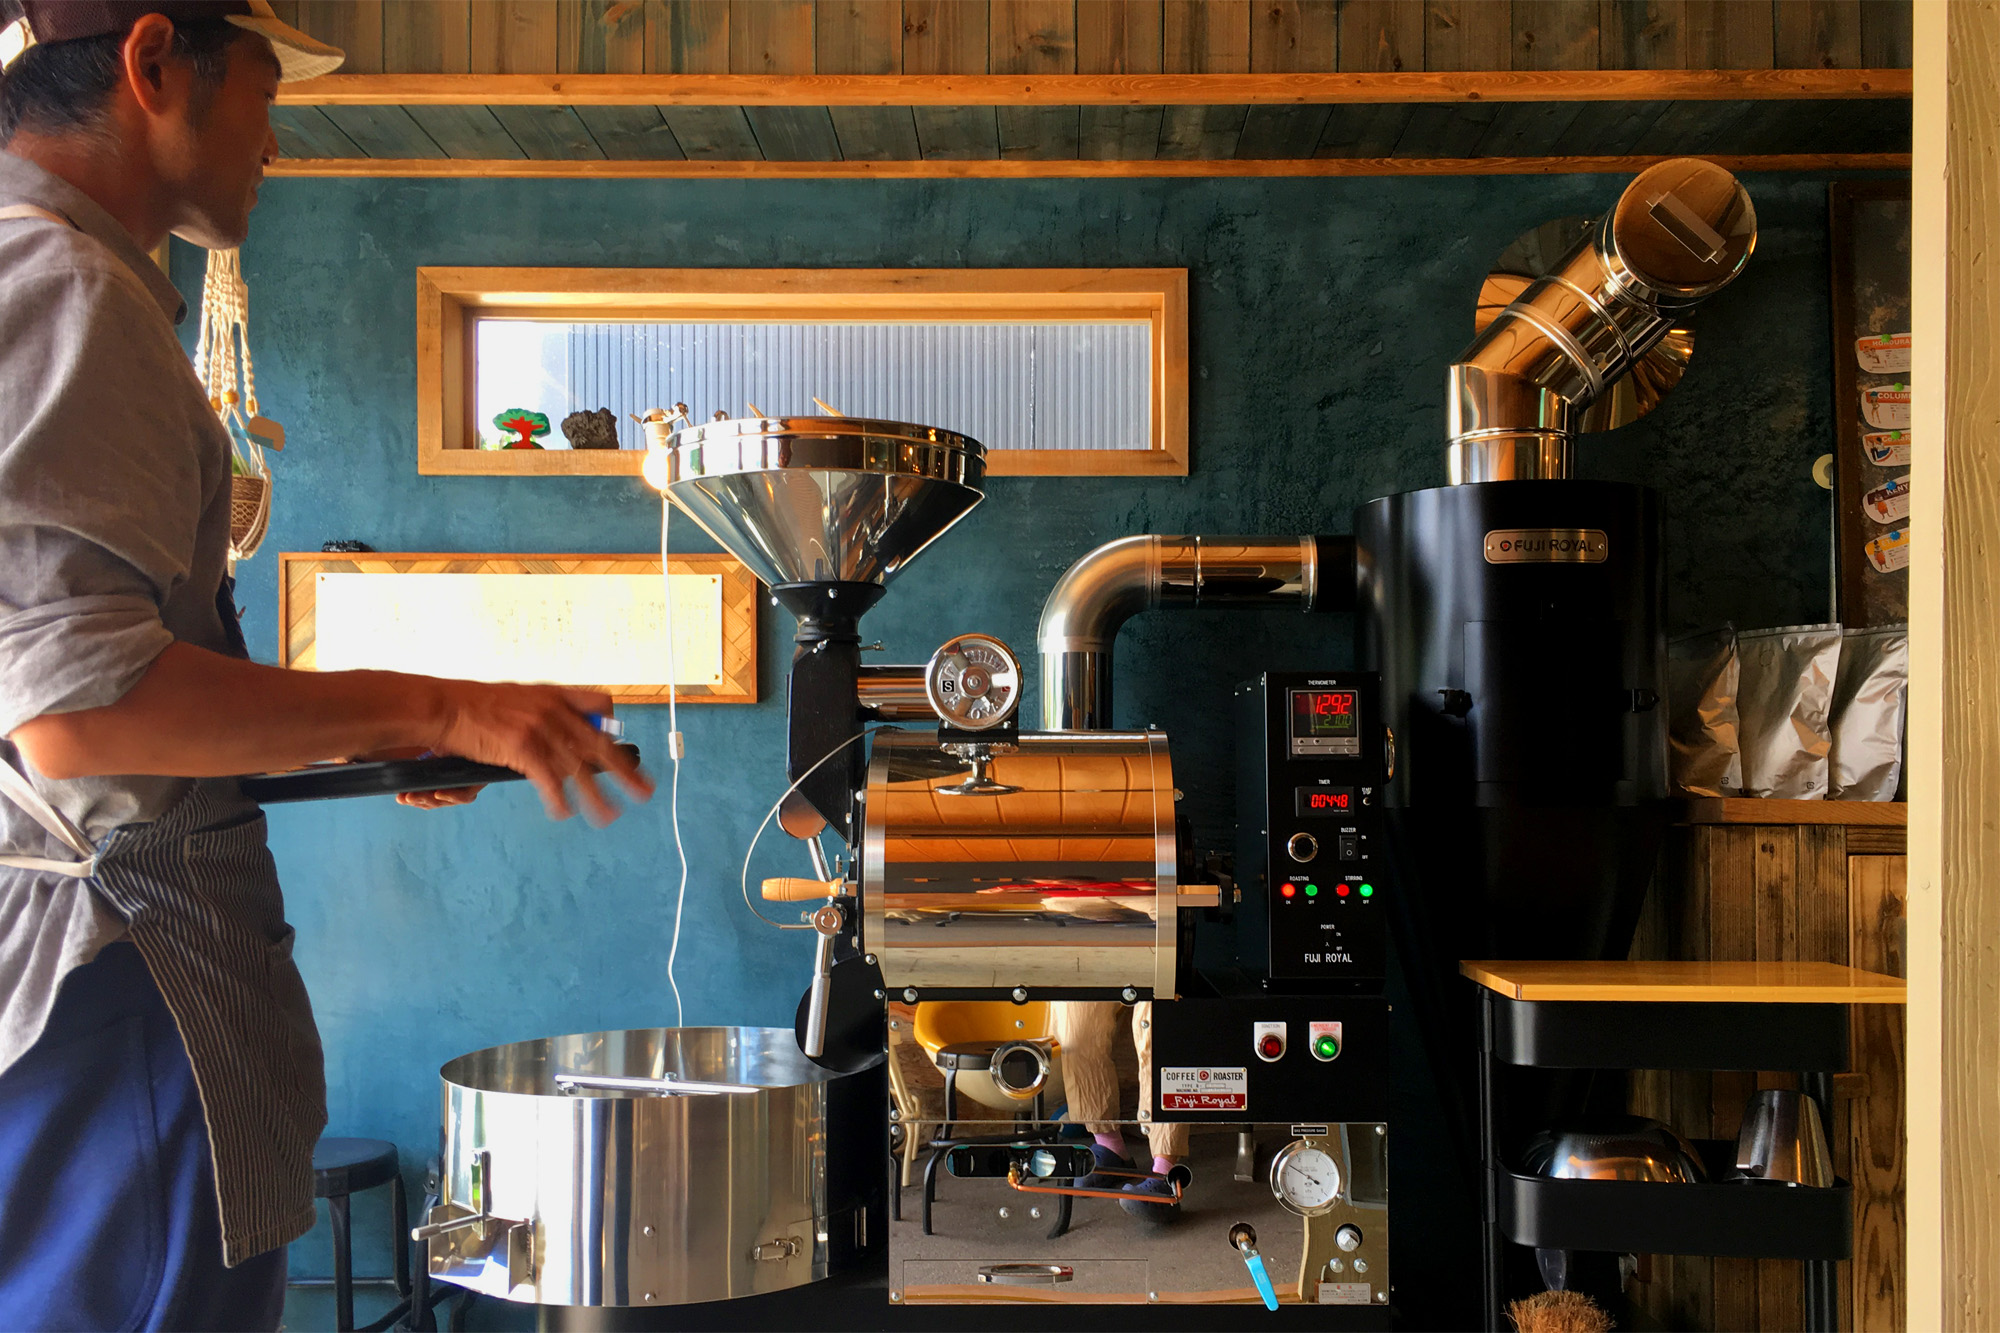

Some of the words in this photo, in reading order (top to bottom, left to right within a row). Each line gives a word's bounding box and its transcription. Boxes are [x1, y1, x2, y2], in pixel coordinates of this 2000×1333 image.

[1514, 540, 1546, 552] FUJI
[1549, 539, 1595, 552] ROYAL
[944, 681, 953, 692] S
[1311, 794, 1348, 808] 00448
[1304, 953, 1321, 963] FUJI
[1325, 953, 1352, 963] ROYAL
[1166, 1072, 1195, 1080] COFFEE
[1213, 1072, 1244, 1080] ROASTER
[1171, 1095, 1198, 1108] Fuji
[1200, 1094, 1238, 1108] Royal
